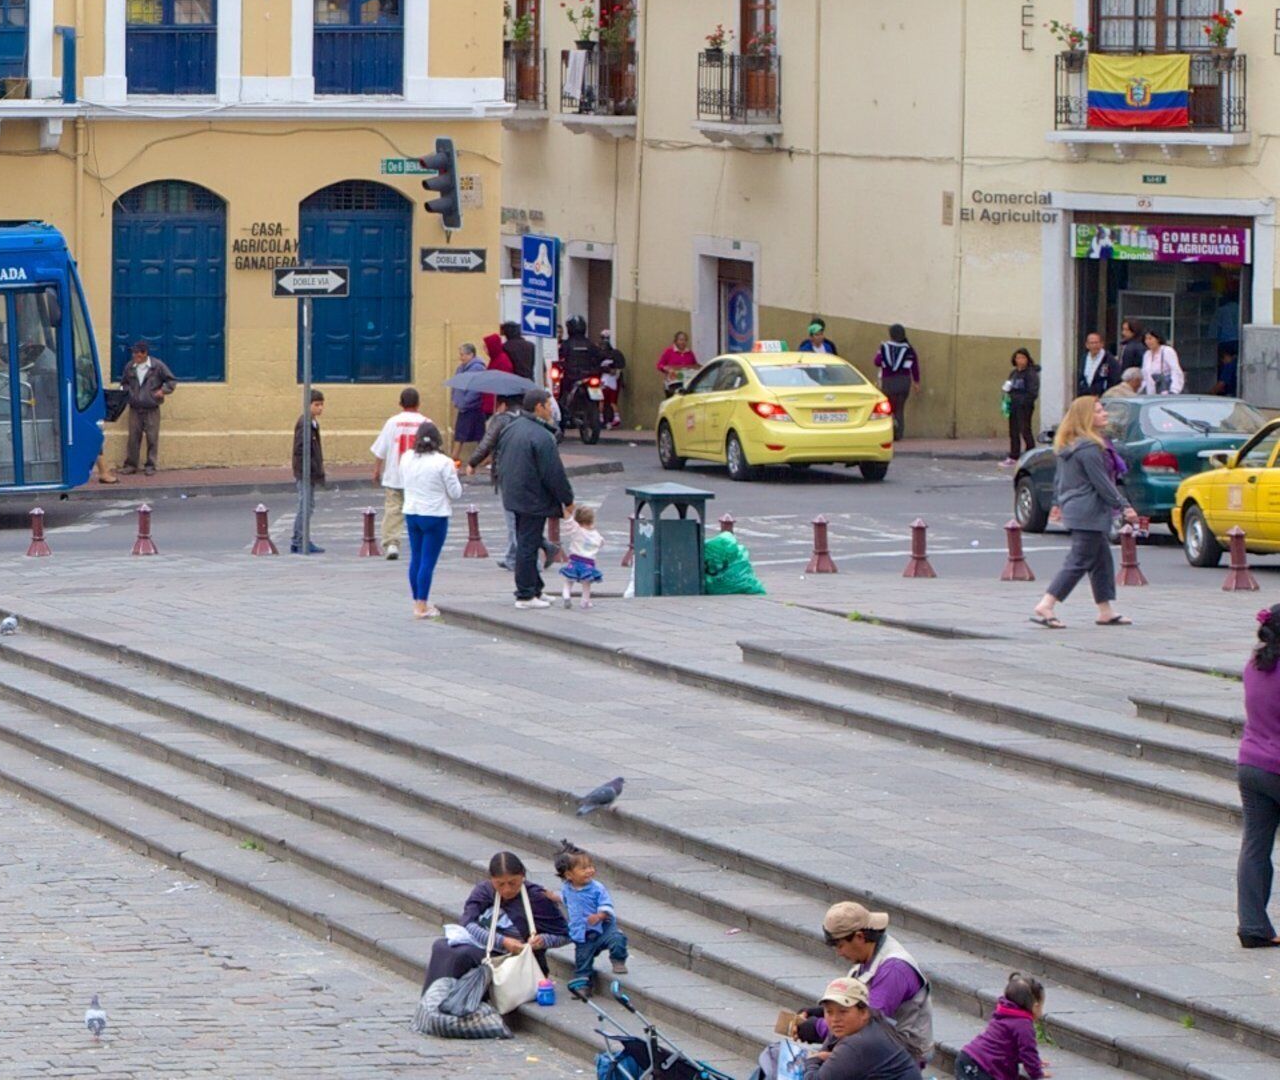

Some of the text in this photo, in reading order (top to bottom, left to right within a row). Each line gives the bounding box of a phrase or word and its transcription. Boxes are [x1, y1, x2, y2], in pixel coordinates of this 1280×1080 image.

[972, 190, 1052, 205] Comercial
[960, 209, 1058, 225] El Agricultor
[251, 222, 283, 236] CASA
[1162, 231, 1239, 244] COMERCIAL
[233, 238, 292, 253] AGRICOLA
[1162, 243, 1239, 256] EL AGRICULTOR
[235, 255, 297, 270] GANADERA
[436, 256, 457, 264] DOBLE
[293, 278, 316, 286] DOBLE
